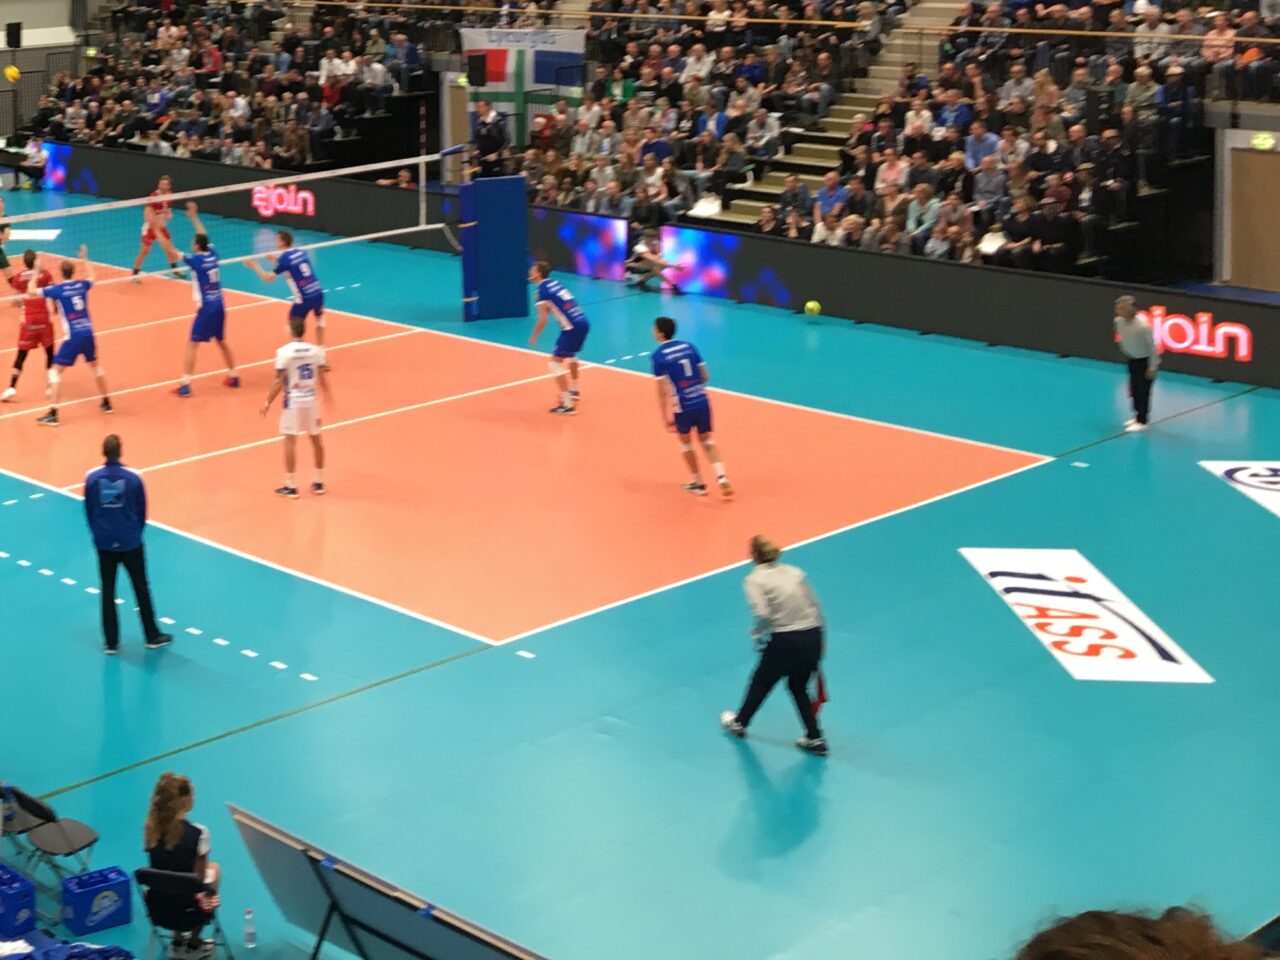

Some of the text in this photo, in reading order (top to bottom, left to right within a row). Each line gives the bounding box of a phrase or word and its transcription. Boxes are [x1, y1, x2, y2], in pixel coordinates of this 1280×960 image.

[299, 262, 312, 277] 9
[71, 295, 84, 311] 5
[1116, 304, 1254, 362] join
[296, 363, 314, 380] 15
[678, 358, 693, 376] 1
